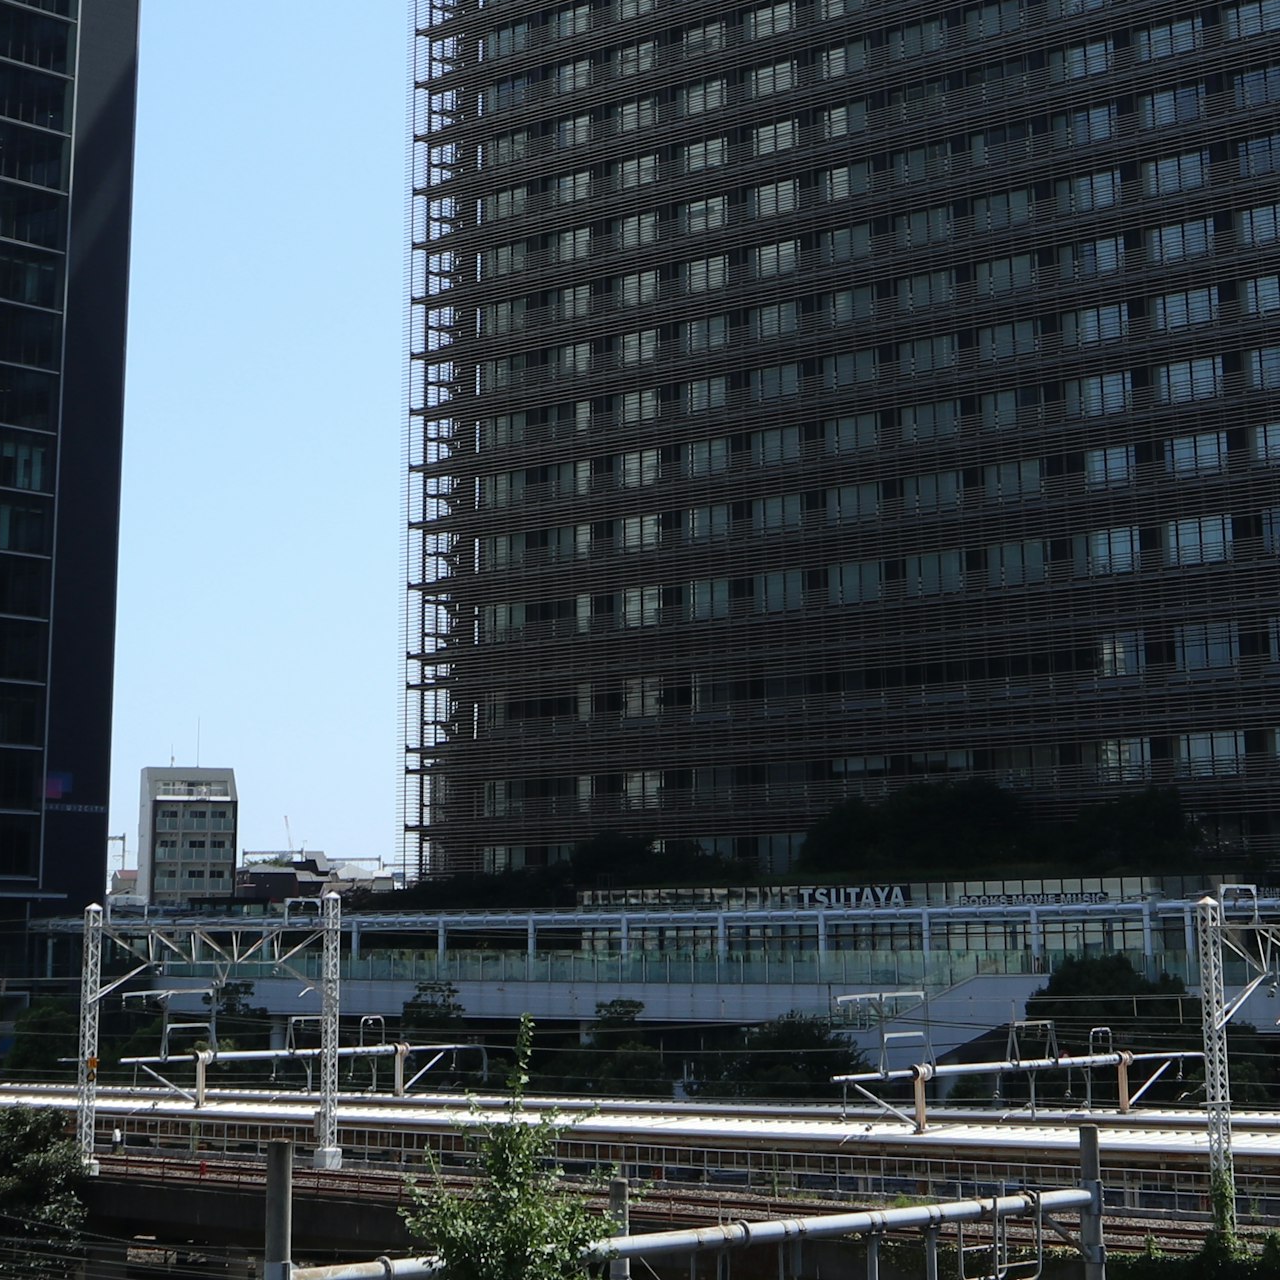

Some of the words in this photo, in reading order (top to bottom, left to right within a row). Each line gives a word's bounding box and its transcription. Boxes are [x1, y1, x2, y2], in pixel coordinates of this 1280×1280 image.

[800, 886, 906, 908] TSUTAYA
[960, 895, 1007, 906] BOOKS
[1013, 894, 1056, 905] MOVIE
[1060, 893, 1106, 904] MUSIC
